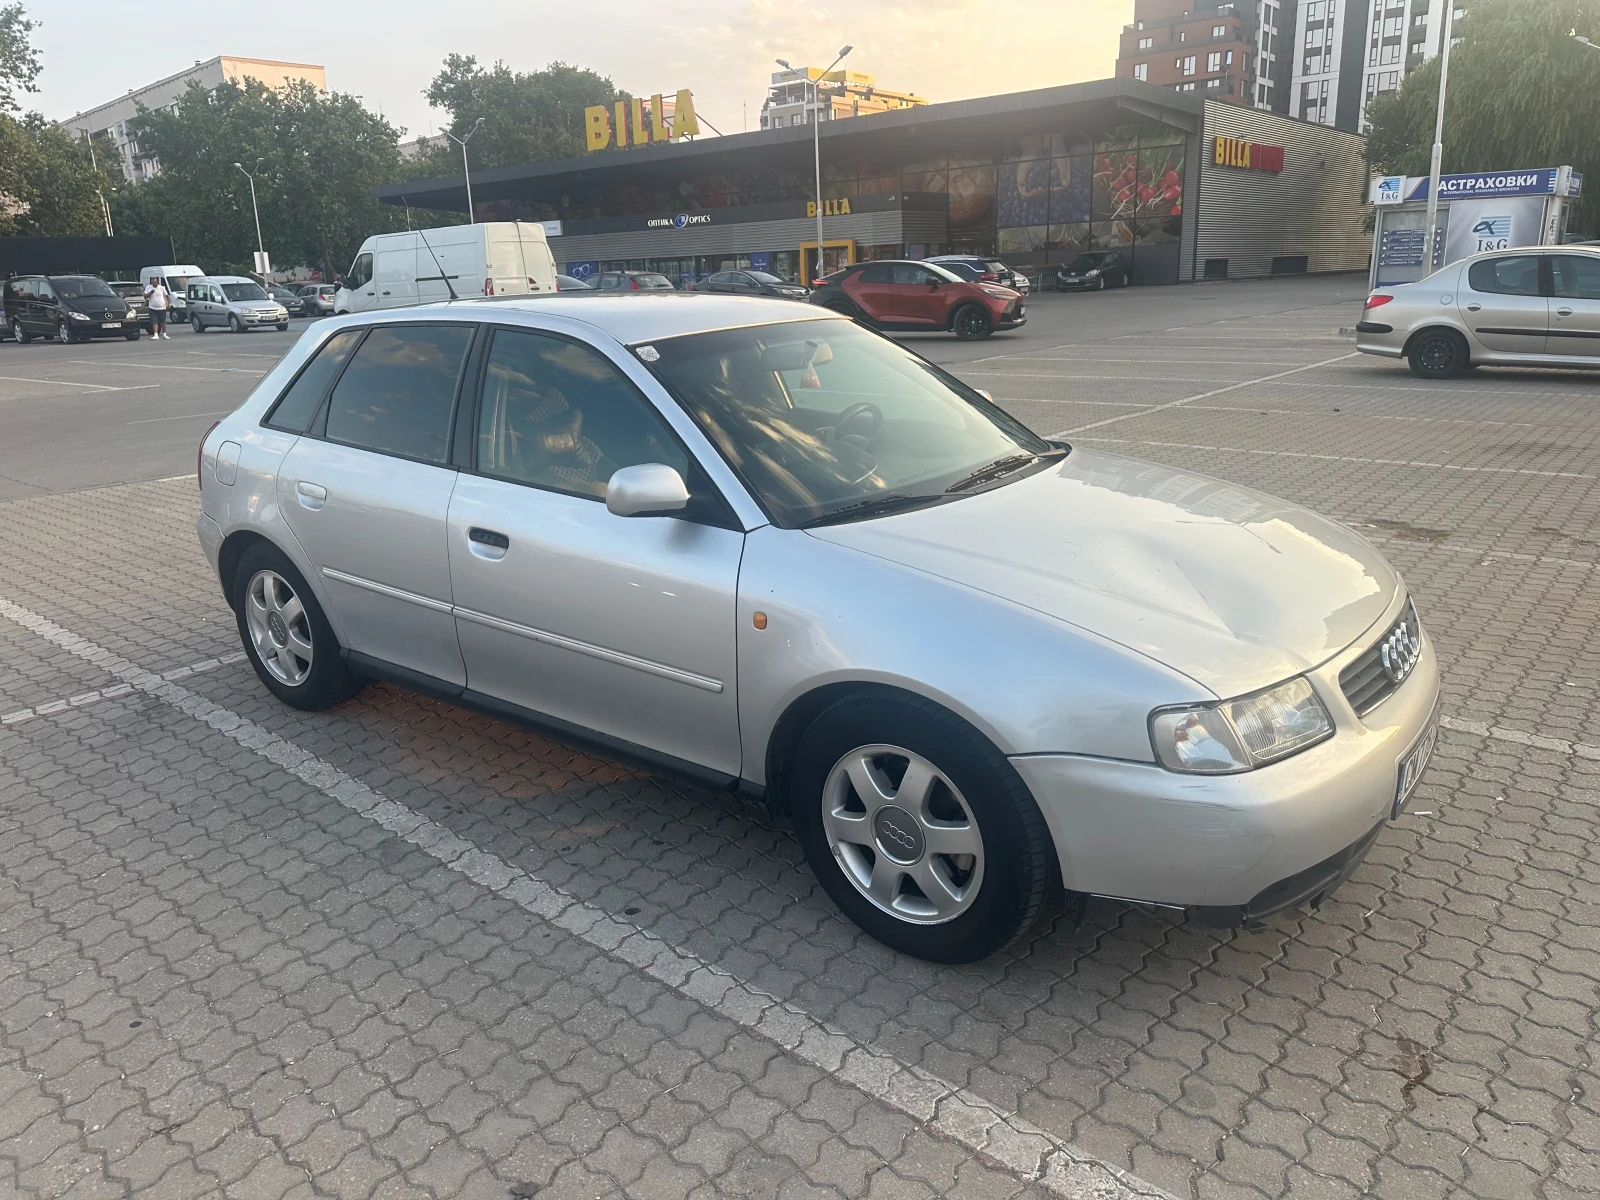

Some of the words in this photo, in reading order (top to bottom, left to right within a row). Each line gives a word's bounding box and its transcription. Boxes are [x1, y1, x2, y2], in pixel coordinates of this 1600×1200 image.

[585, 89, 700, 151] BILLA
[1215, 136, 1250, 168] BILLA
[1437, 174, 1538, 191] АСТРАХОВКИ
[806, 197, 851, 218] BILLA
[647, 218, 673, 228] ОПТИКА
[689, 214, 711, 224] OPTICS
